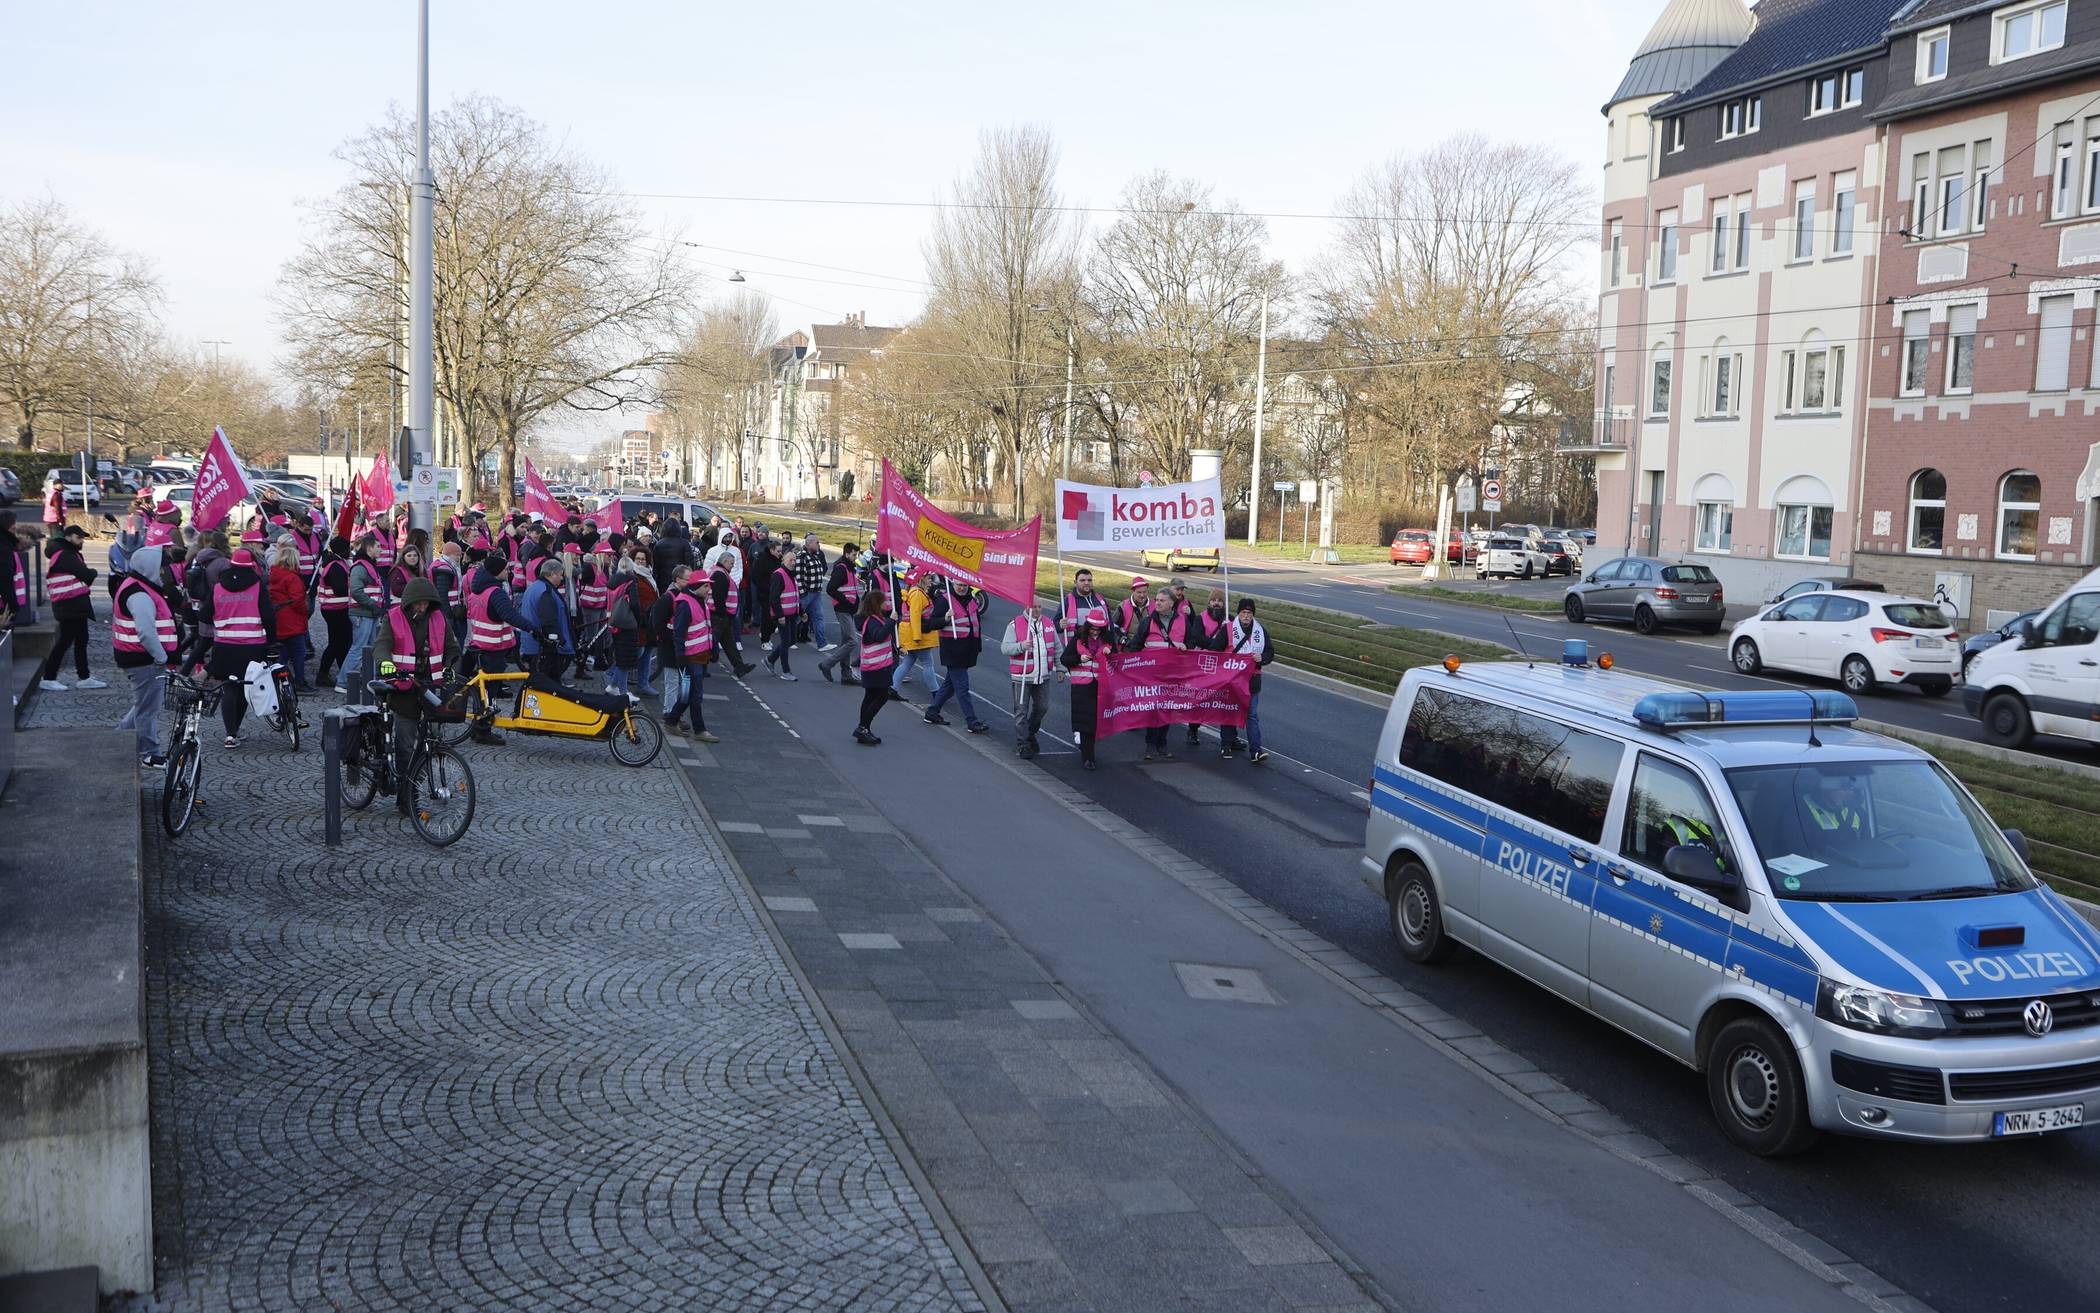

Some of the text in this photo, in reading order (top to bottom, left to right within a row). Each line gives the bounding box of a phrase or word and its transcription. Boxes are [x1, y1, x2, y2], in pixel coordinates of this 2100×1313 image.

[1112, 492, 1215, 522] komba
[1112, 518, 1216, 542] gewerkschaft
[924, 528, 974, 559] KREFELD
[983, 551, 1025, 566] sind wir
[1223, 659, 1248, 671] dbb
[1130, 702, 1155, 712] Arbeit
[1211, 701, 1239, 711] Dienst
[1497, 840, 1572, 896] POLIZEI
[1946, 952, 2088, 986] POLIZEI
[2004, 1107, 2082, 1132] NRW 5-2642
